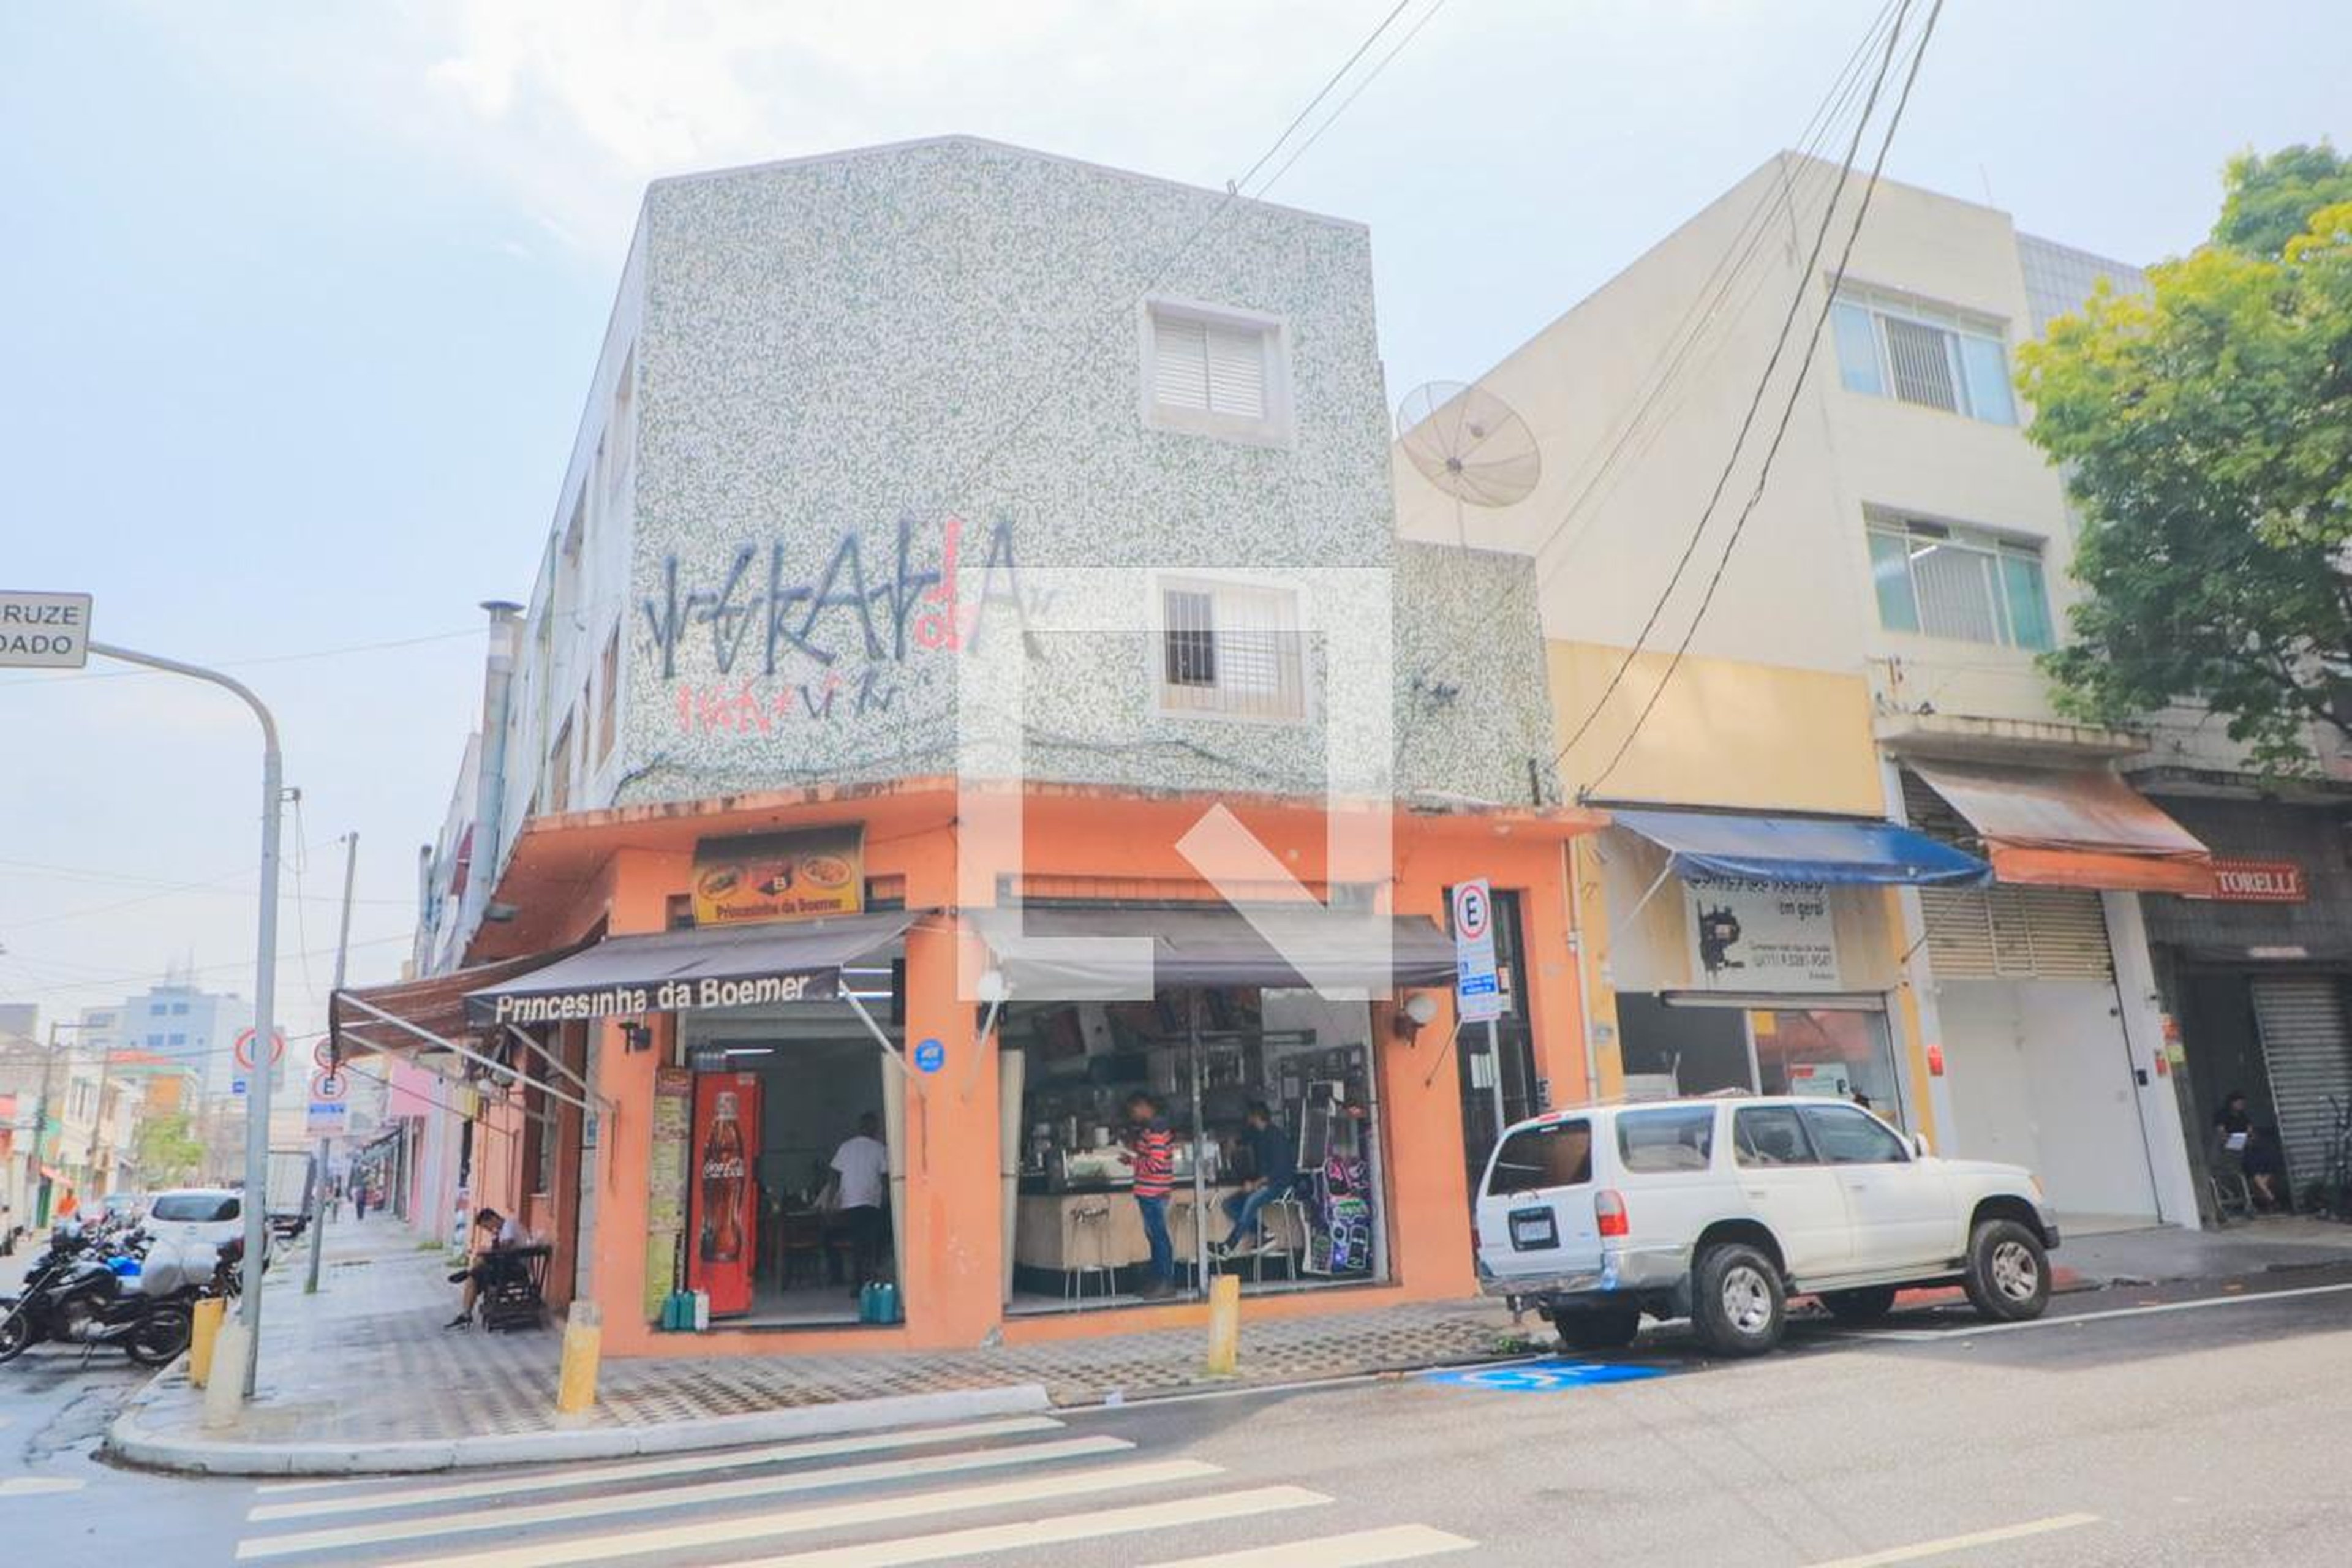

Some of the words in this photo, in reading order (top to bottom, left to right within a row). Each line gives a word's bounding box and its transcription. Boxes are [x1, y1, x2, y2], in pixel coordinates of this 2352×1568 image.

[2215, 870, 2297, 893] TORELLI
[1466, 896, 1479, 925] E
[496, 986, 647, 1023] Princesinha
[657, 980, 691, 1008] da
[699, 975, 810, 1008] Boemer
